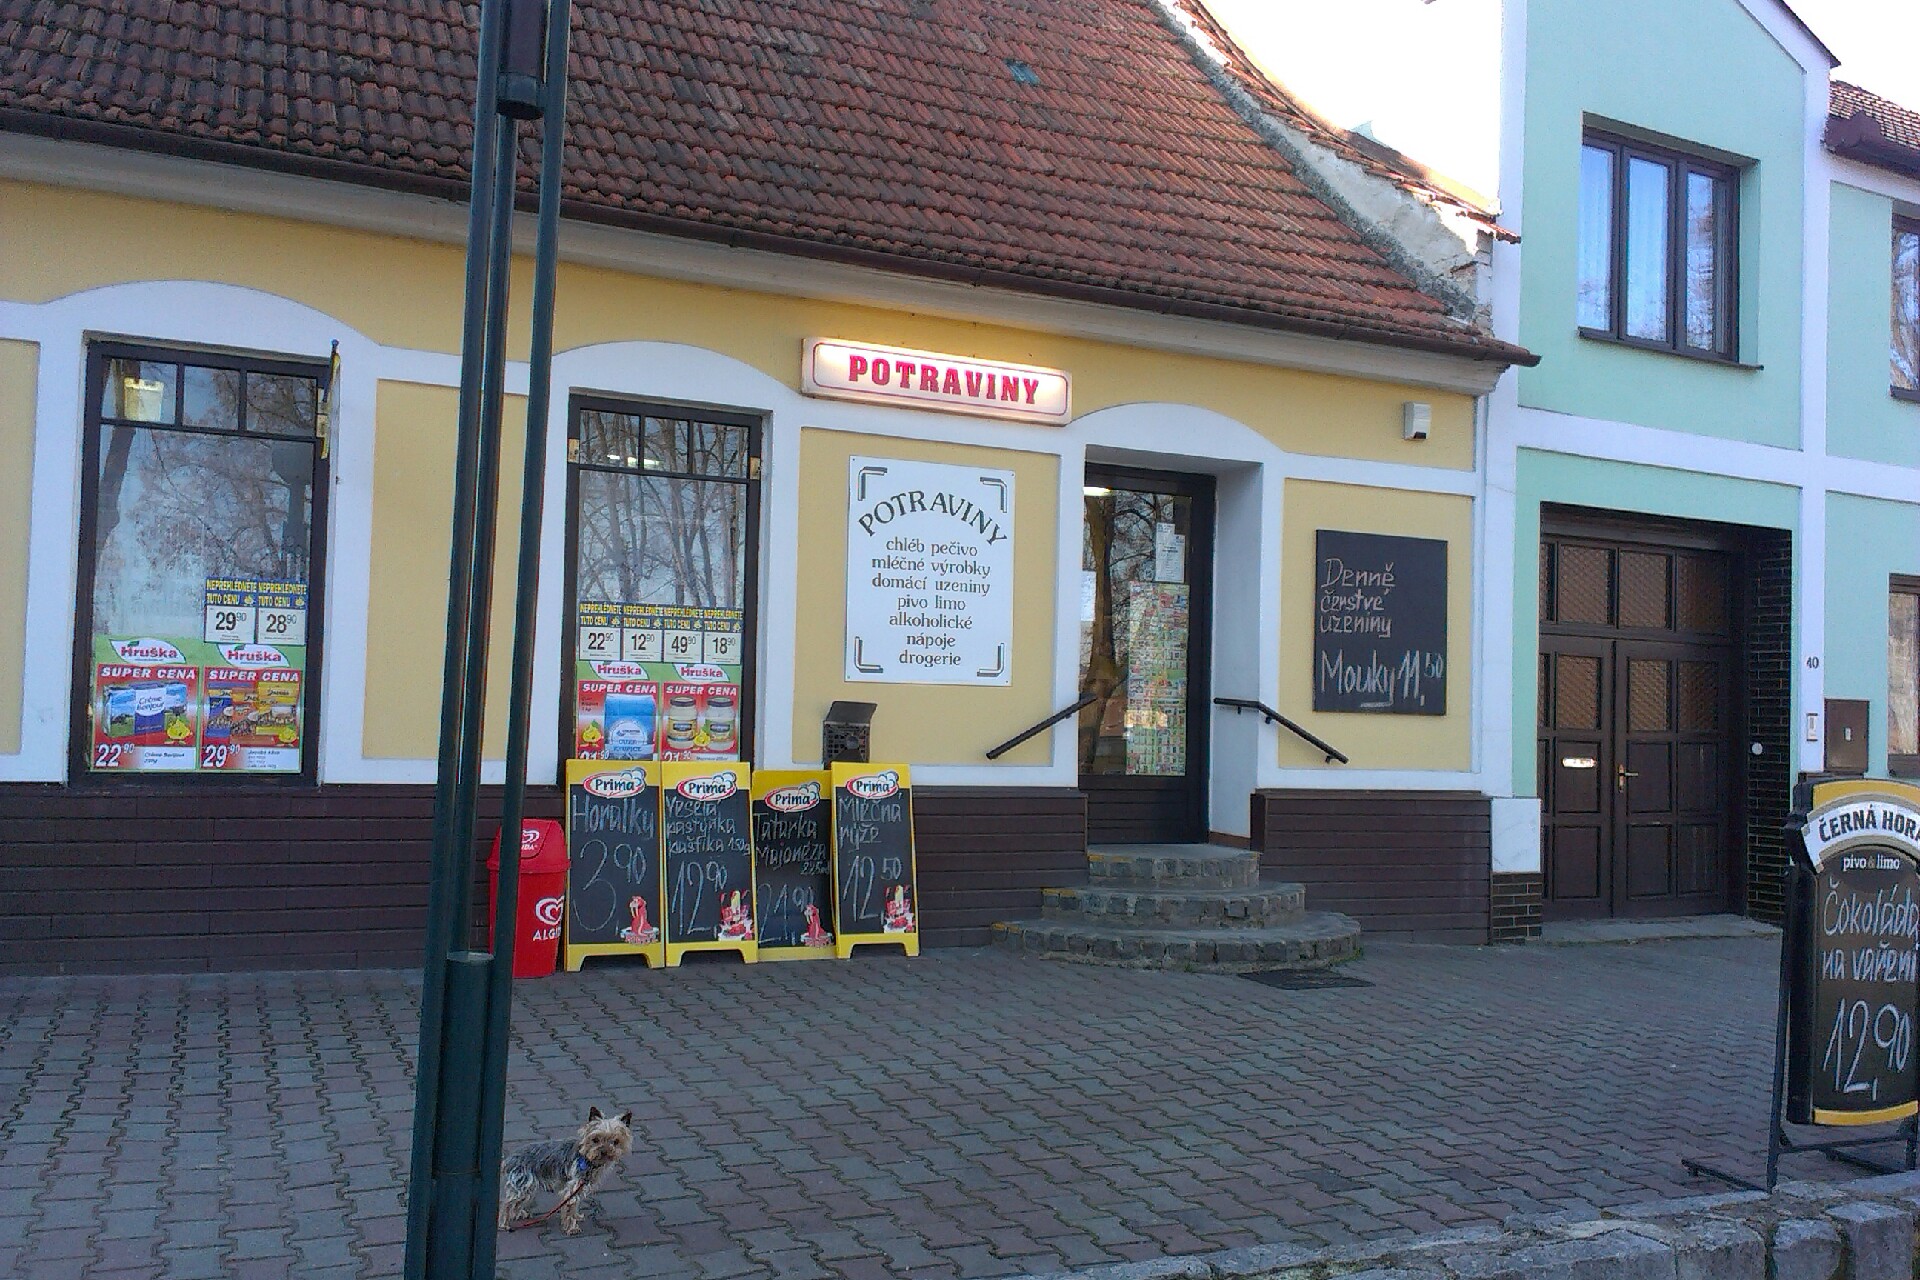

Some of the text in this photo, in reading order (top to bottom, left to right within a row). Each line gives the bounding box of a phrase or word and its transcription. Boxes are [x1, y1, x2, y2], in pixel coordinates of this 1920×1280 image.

[849, 355, 1039, 405] POTRAVINY
[858, 490, 1008, 546] POTRAVINY
[886, 537, 978, 558] chléb pečivo
[871, 556, 991, 577] mléčné výrobky
[1321, 558, 1396, 588] Denně
[872, 576, 990, 596] domácí uzeniny
[898, 595, 966, 611] pivo limo
[889, 612, 973, 630] alkoholické
[907, 633, 956, 648] nápoje
[121, 646, 177, 658] Hruška
[228, 650, 281, 661] Hruška
[899, 651, 961, 667] drogerie
[597, 664, 642, 675] Hruška
[1806, 656, 1819, 669] 40
[101, 667, 195, 680] SUPER CENA
[209, 670, 299, 682] SUPER CENA
[680, 667, 723, 678] Hruška
[1321, 649, 1395, 708] Mouky
[582, 683, 657, 694] SUPER CENA
[666, 685, 737, 696] SUPER CENA
[595, 778, 635, 792] Prima
[688, 782, 727, 795] Prima
[856, 779, 891, 793] Prima
[775, 793, 811, 806] Prima
[572, 794, 654, 841] Horalky
[1819, 804, 1877, 842] ČERNÁ
[753, 812, 818, 842] Tatarka
[1843, 854, 1867, 872] pivo
[1876, 854, 1900, 870] limo
[1823, 876, 1919, 940] Čokoláda
[1822, 949, 1845, 980] na
